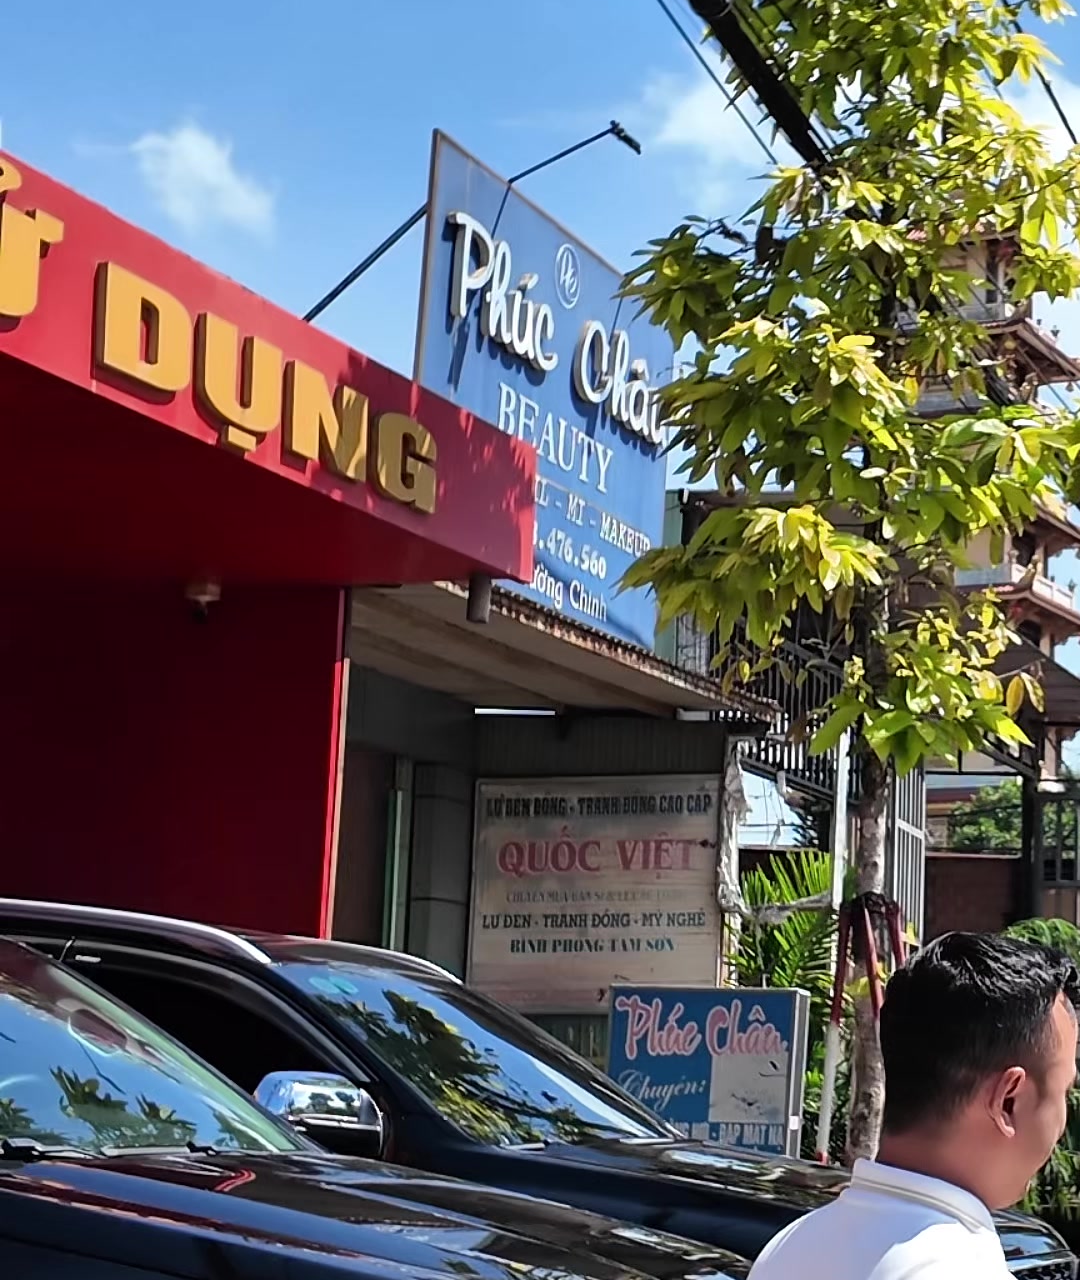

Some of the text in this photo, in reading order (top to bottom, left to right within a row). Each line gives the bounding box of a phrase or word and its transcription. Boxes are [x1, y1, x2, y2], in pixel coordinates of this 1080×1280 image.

[448, 211, 558, 371] Phúc
[93, 261, 437, 514] DỤNG
[498, 383, 613, 494] BEAUTY
[533, 520, 607, 579] .476.560
[569, 579, 608, 623] Chinh
[498, 825, 698, 879] QUỐC VIỆT
[543, 912, 587, 928] TRANH
[552, 938, 604, 953] PHONG
[615, 995, 786, 1060] Phúc Châu
